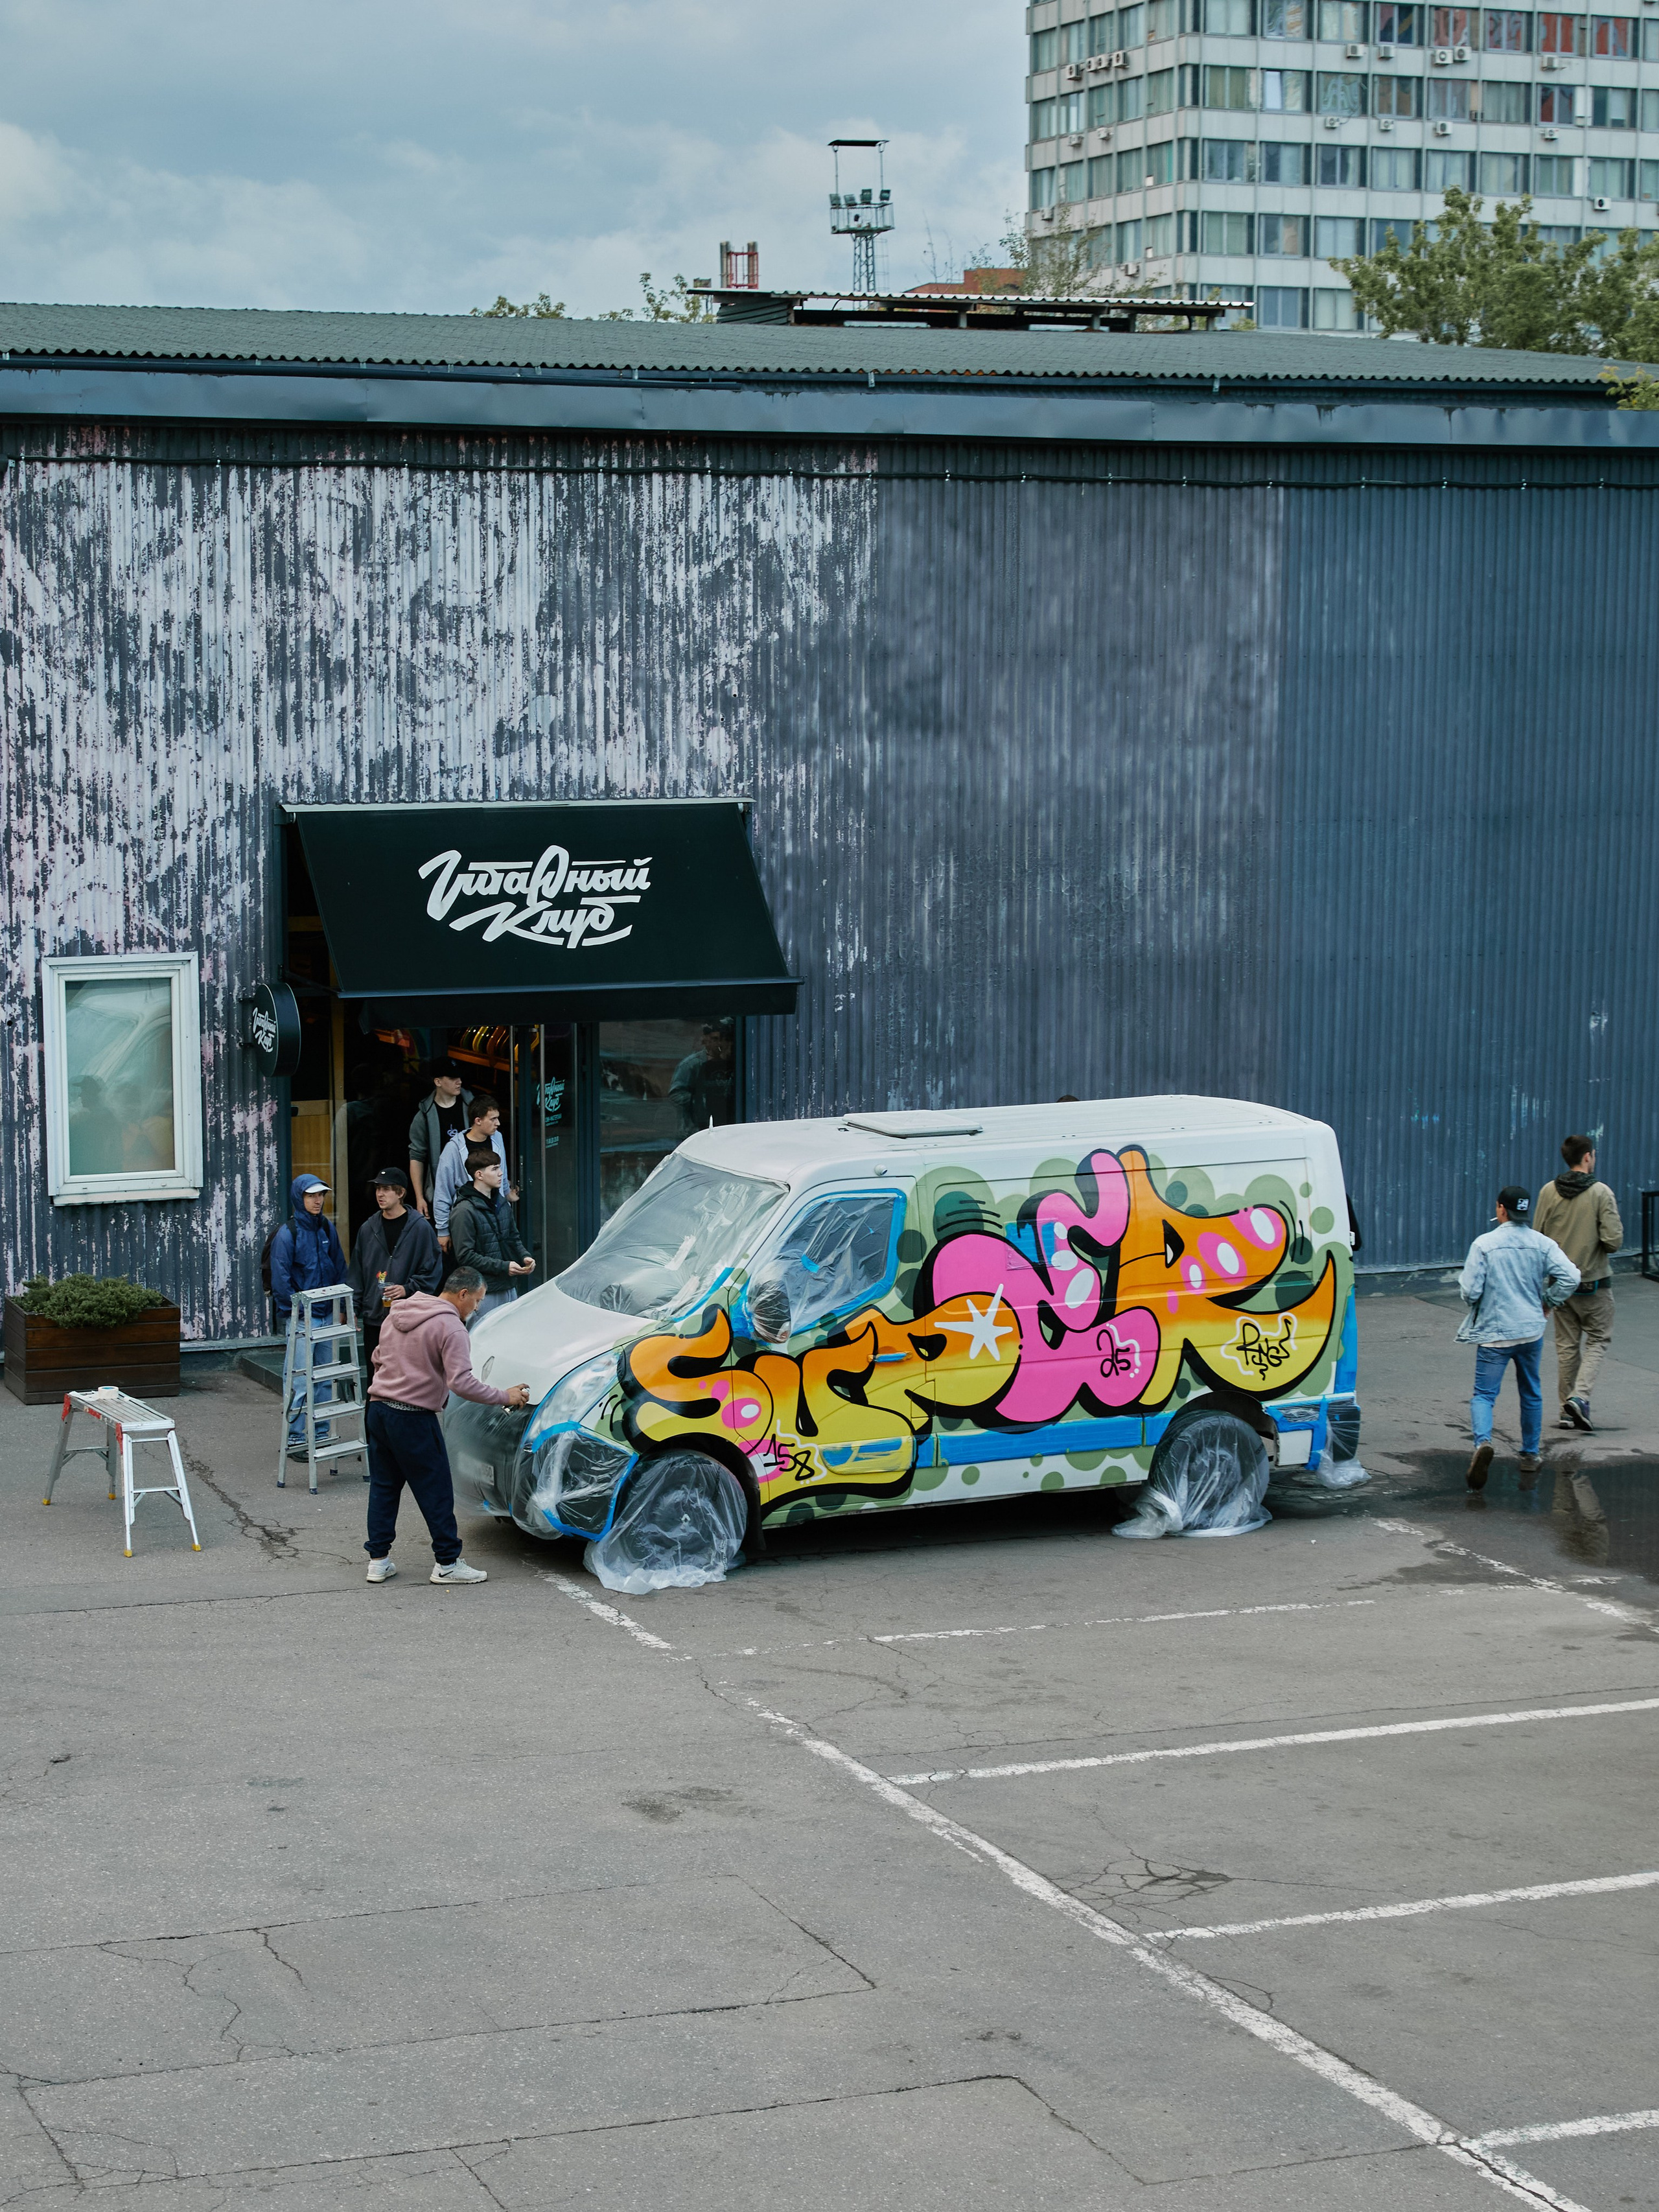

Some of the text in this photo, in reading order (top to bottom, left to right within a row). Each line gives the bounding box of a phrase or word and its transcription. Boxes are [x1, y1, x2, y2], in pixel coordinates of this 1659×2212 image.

[448, 895, 642, 949] Клуб
[1096, 1329, 1131, 1378] 25
[763, 1433, 815, 1481] 158
